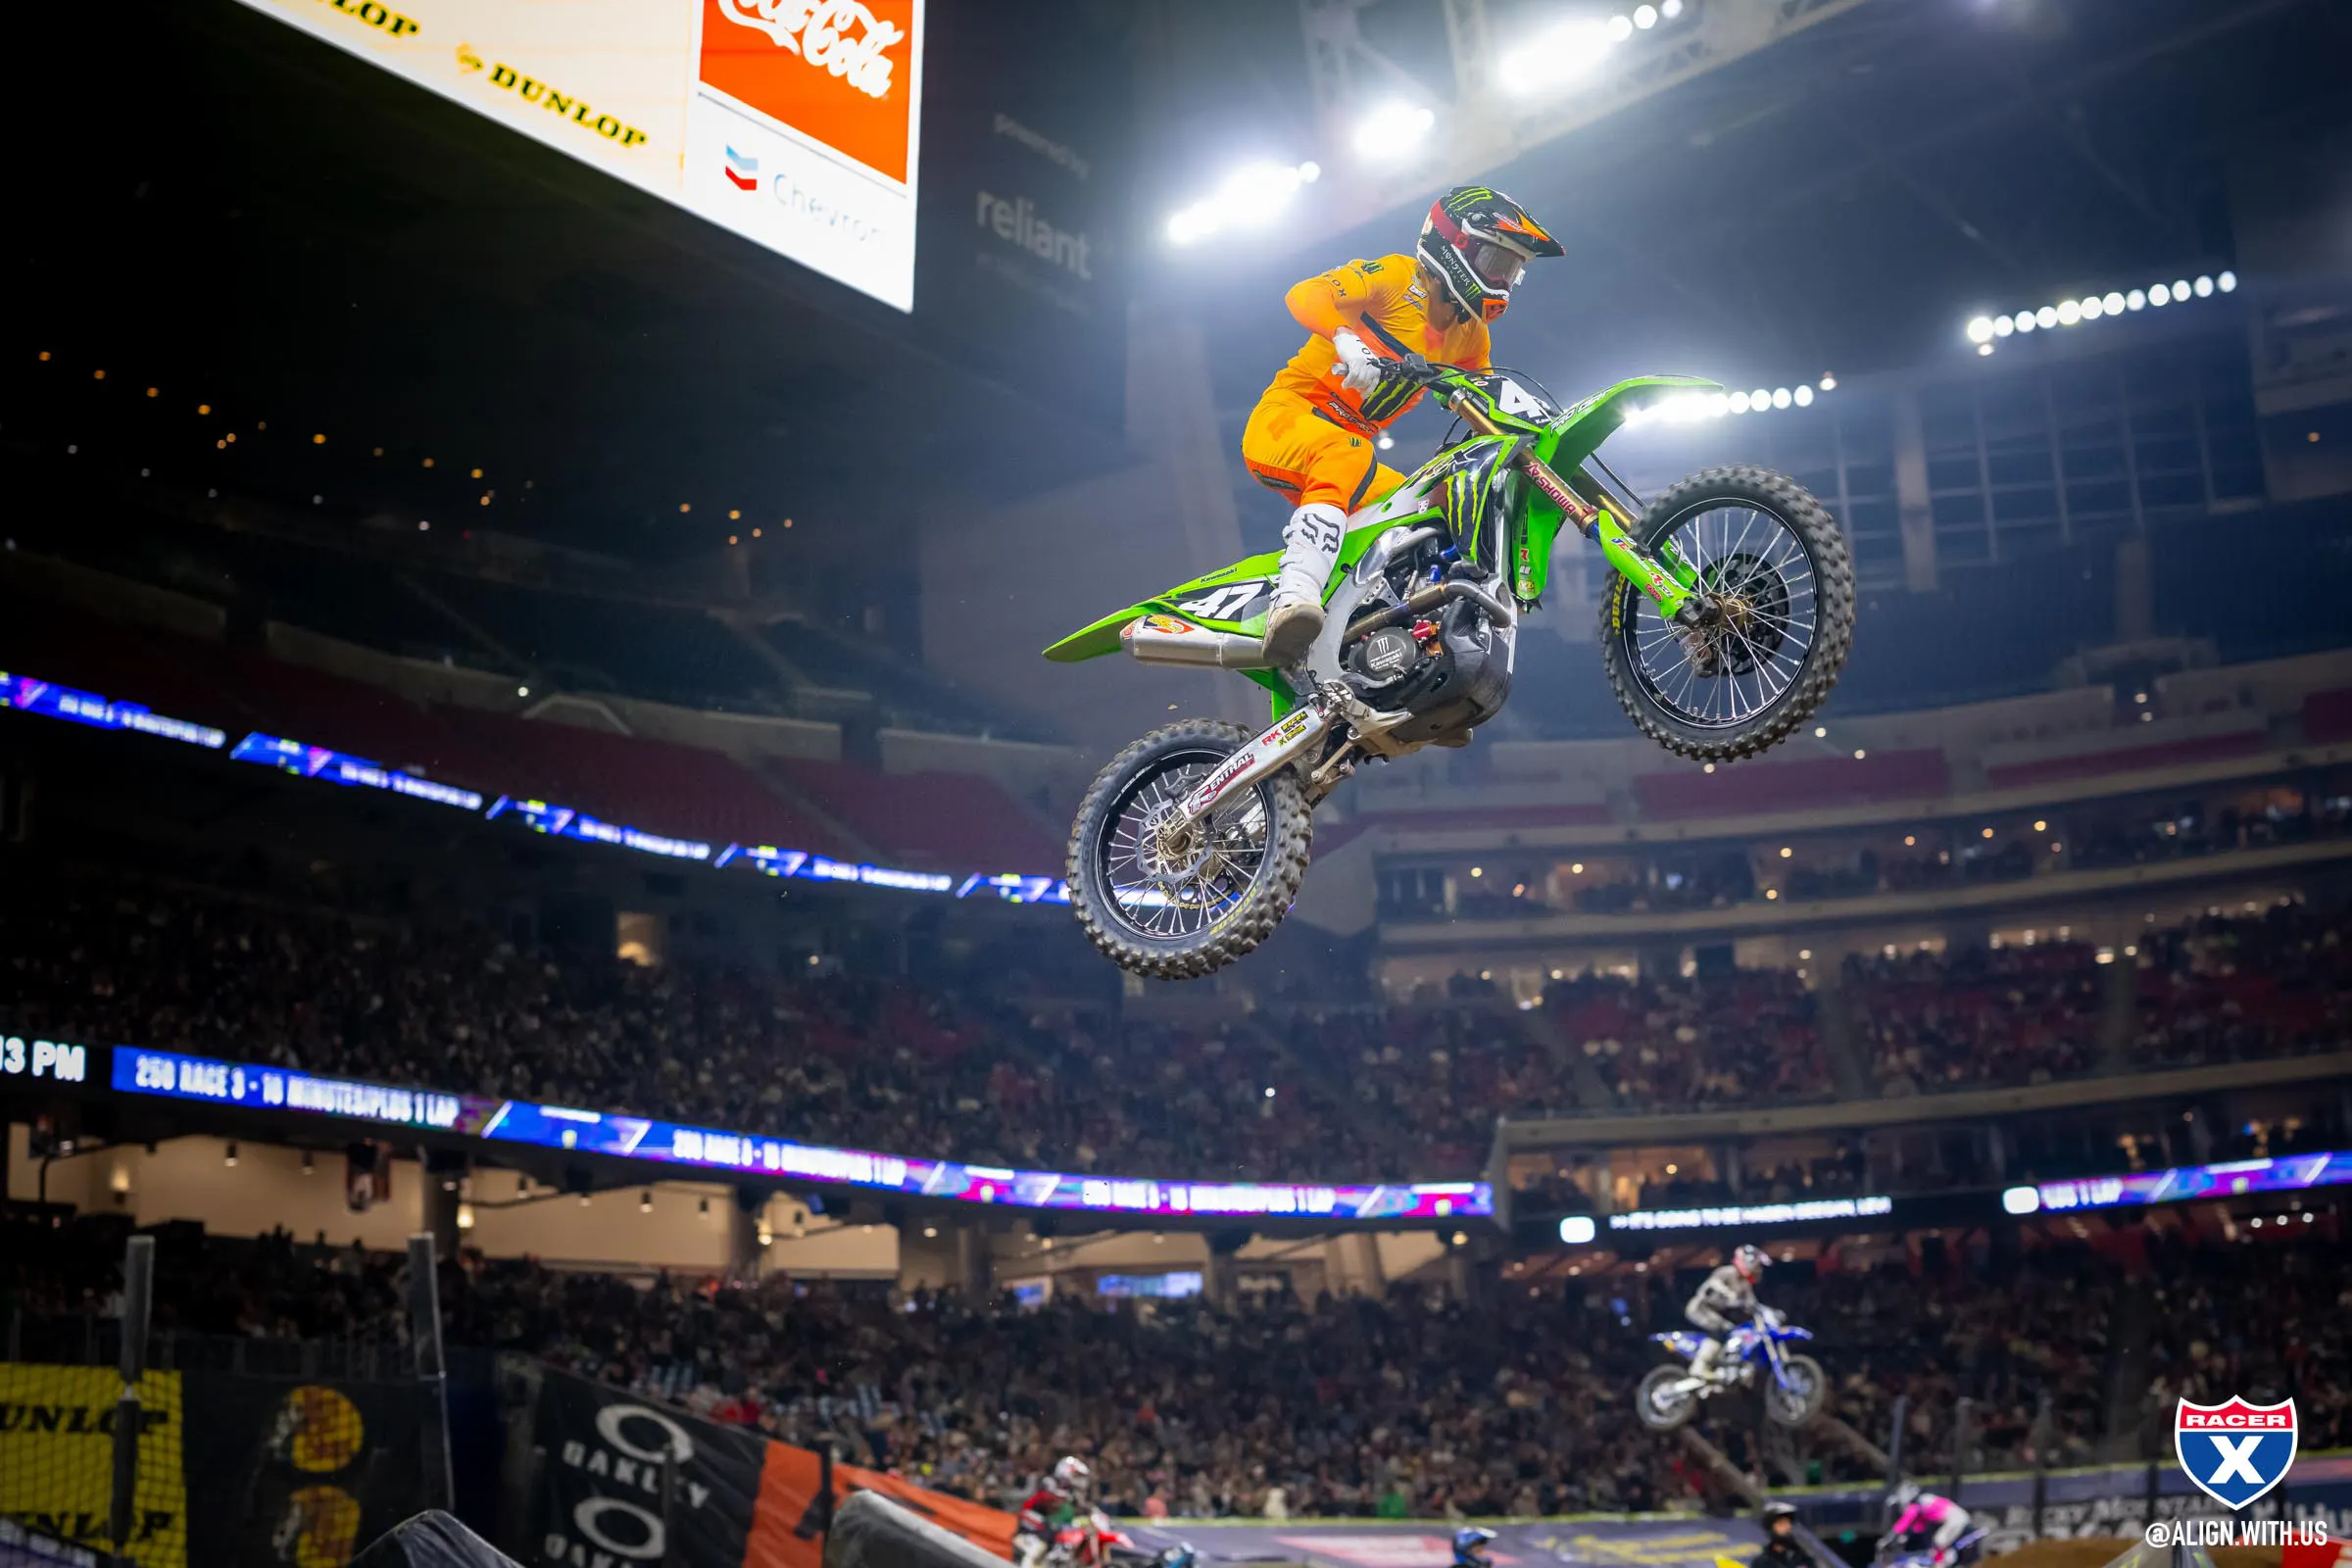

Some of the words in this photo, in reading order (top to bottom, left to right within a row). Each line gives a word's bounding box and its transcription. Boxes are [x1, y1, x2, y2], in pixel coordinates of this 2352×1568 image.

[489, 63, 648, 148] DUNLOP
[977, 190, 1093, 281] reliant
[1324, 273, 1348, 298] FOX
[1440, 245, 1471, 286] MONSTER
[1536, 476, 1577, 516] SHOWA
[1200, 567, 1239, 585] Kawasaki
[1178, 583, 1265, 619] 47
[1261, 729, 1283, 746] RK
[1188, 753, 1255, 815] RENTHAL
[31, 1041, 86, 1083] PM
